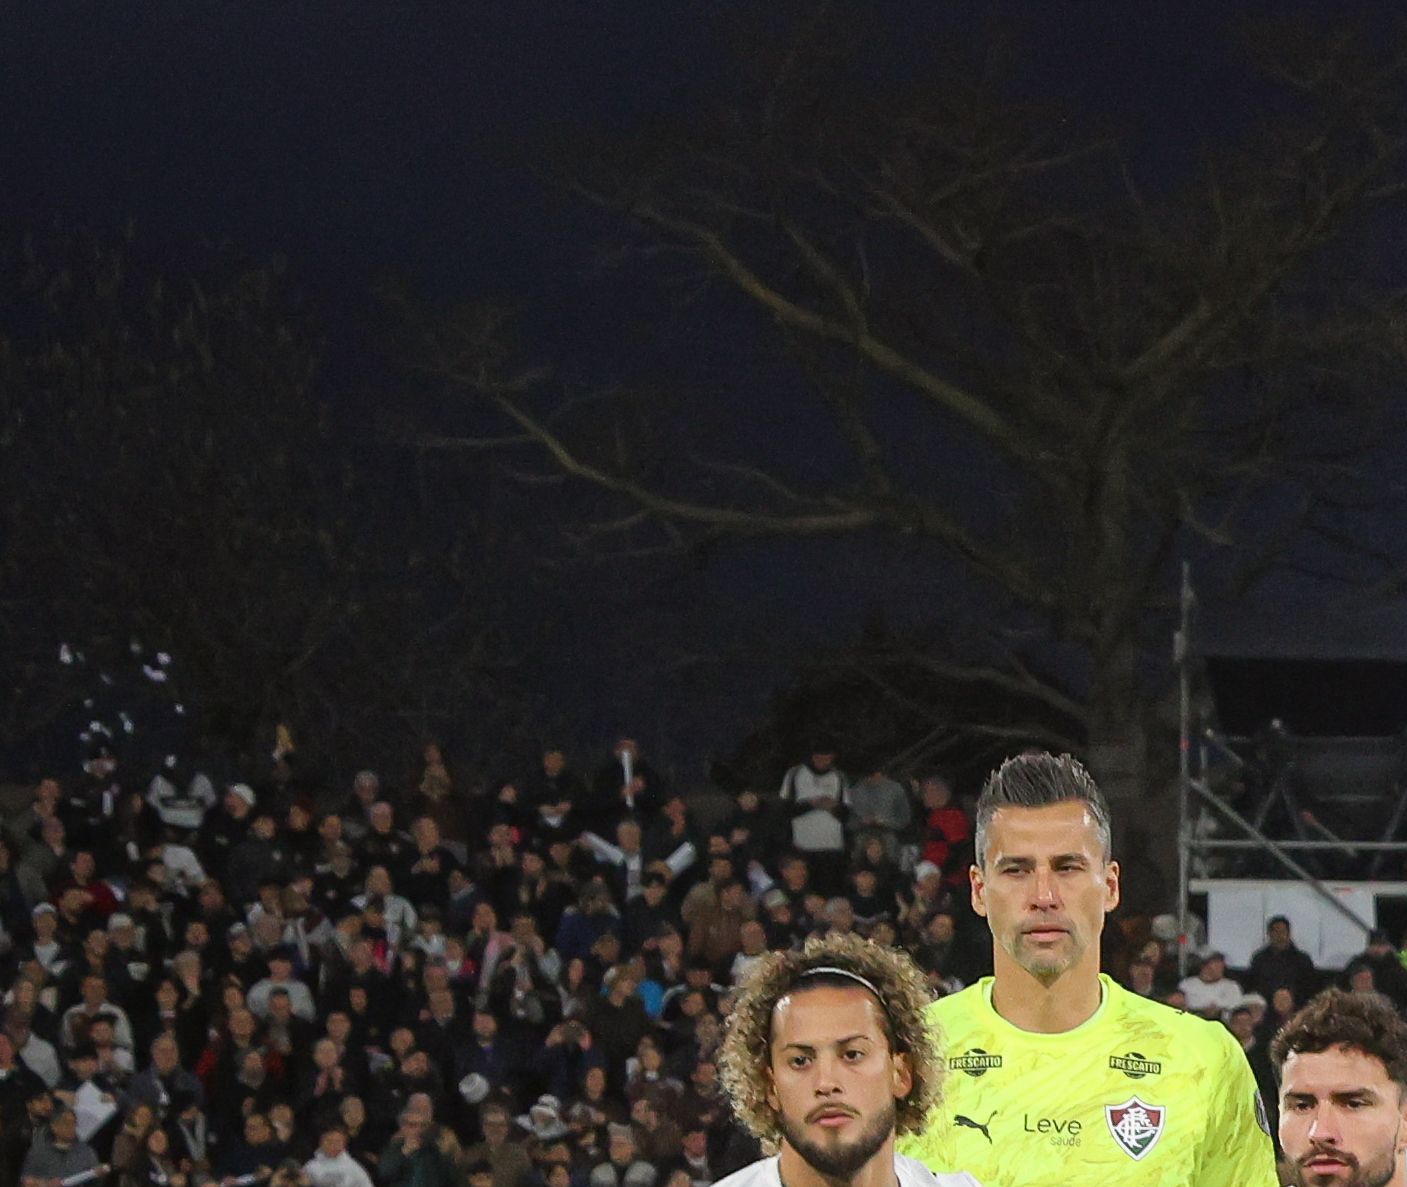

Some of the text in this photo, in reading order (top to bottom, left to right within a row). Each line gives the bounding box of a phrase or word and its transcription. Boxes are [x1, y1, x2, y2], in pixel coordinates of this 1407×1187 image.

[951, 1056, 1002, 1067] FRESCATTO
[1109, 1056, 1160, 1074] FRESCATTO
[1024, 1113, 1082, 1135] Leve
